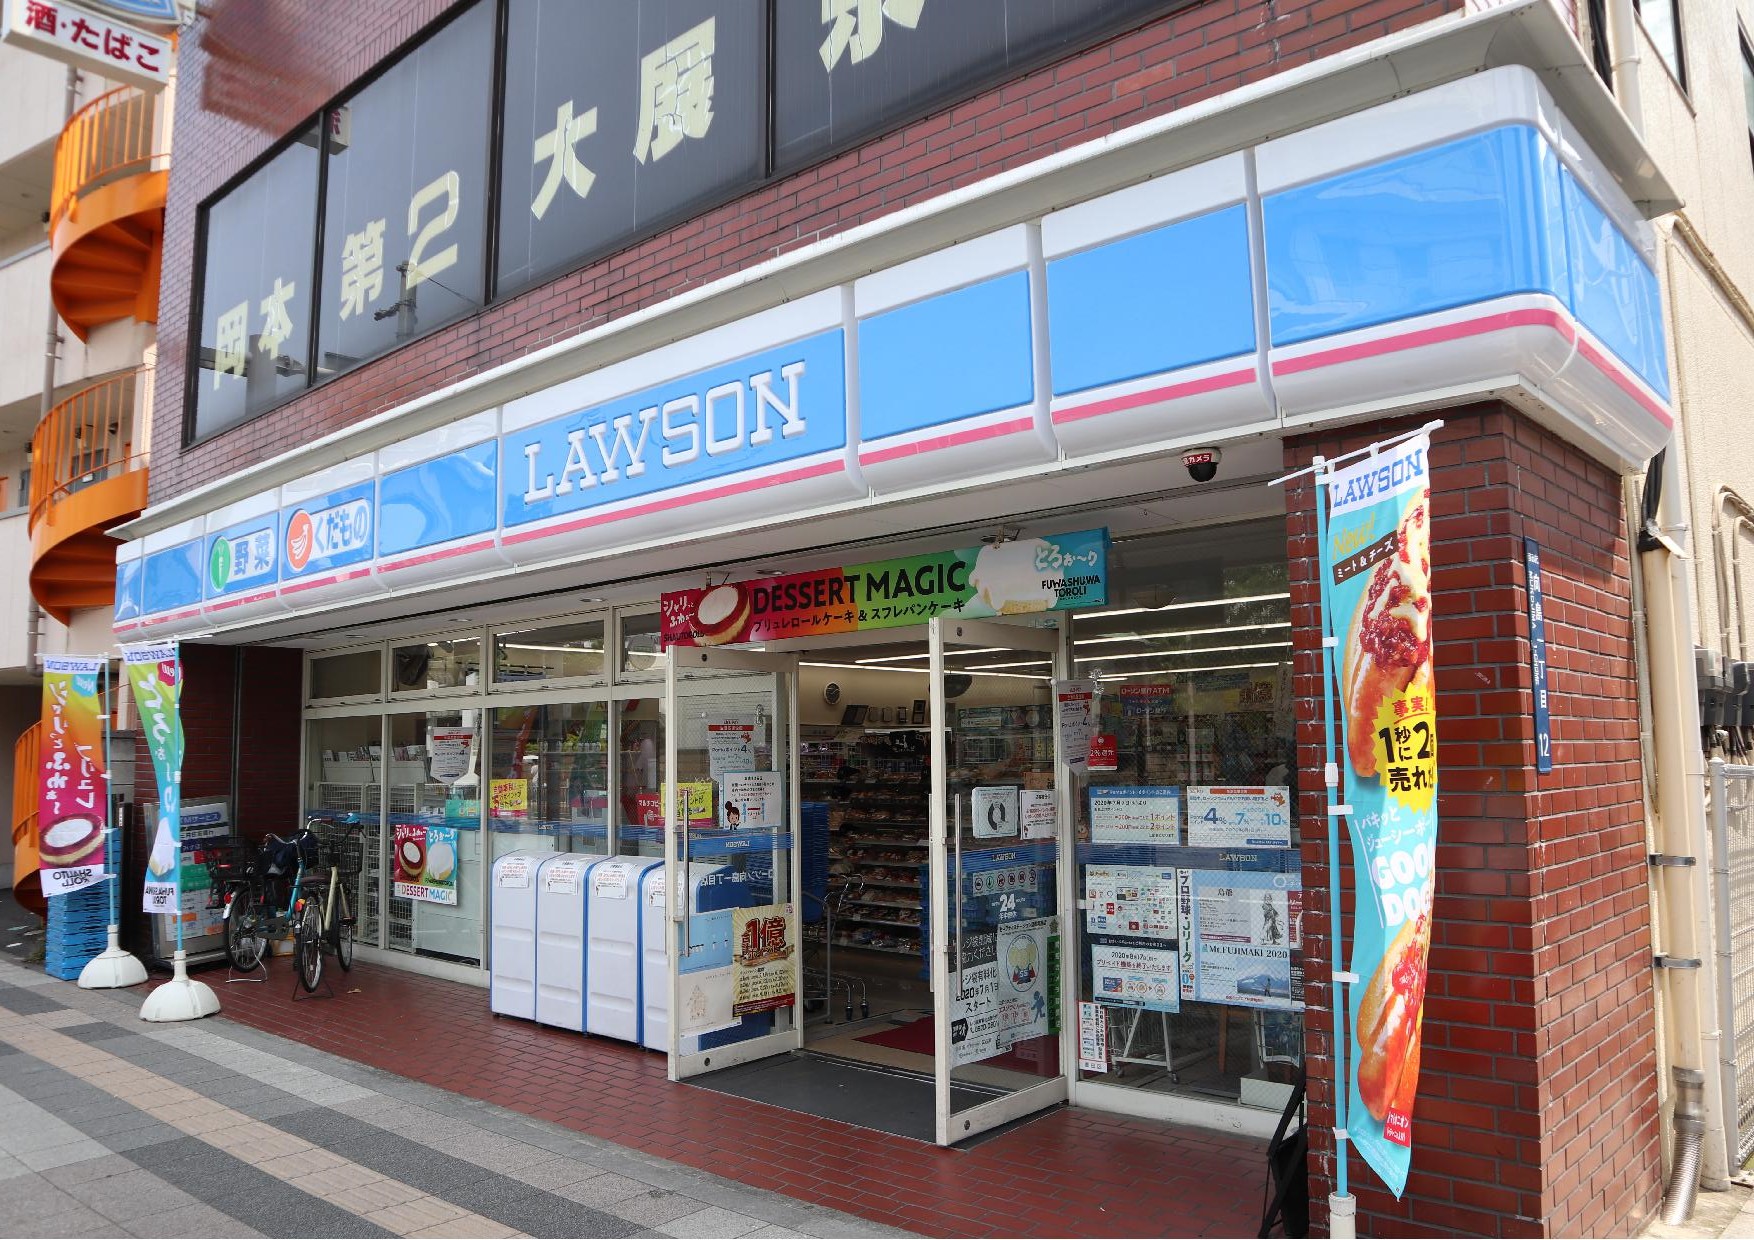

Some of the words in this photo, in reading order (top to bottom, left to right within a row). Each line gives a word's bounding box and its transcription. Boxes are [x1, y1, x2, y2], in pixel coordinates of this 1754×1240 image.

[26, 1, 160, 72] 酒・たばこ
[524, 360, 806, 505] LAWSON
[1333, 448, 1424, 508] LAWSON
[314, 504, 370, 554] くだもの
[1332, 511, 1376, 561] New!
[233, 531, 271, 576] 野菜
[1337, 536, 1395, 578] ミート&チーズ
[753, 573, 861, 614] DESSERT
[866, 560, 966, 602] MAGIC
[1041, 574, 1101, 590] FUWASHUWA
[1054, 585, 1087, 598] TOROLI
[1528, 570, 1537, 629] MUKOJIMA
[753, 610, 855, 633] ブリュレロールケーキ
[858, 609, 868, 622] &
[871, 597, 966, 621] スフレパンケーキ
[1539, 733, 1550, 757] 12
[991, 852, 1016, 862] LAWSON
[1219, 853, 1258, 862] LAWSON
[402, 884, 428, 898] DESSERT
[1000, 893, 1016, 912] 24
[1180, 875, 1192, 963] プロ野球・Jリーグ
[1266, 949, 1288, 959] 2020
